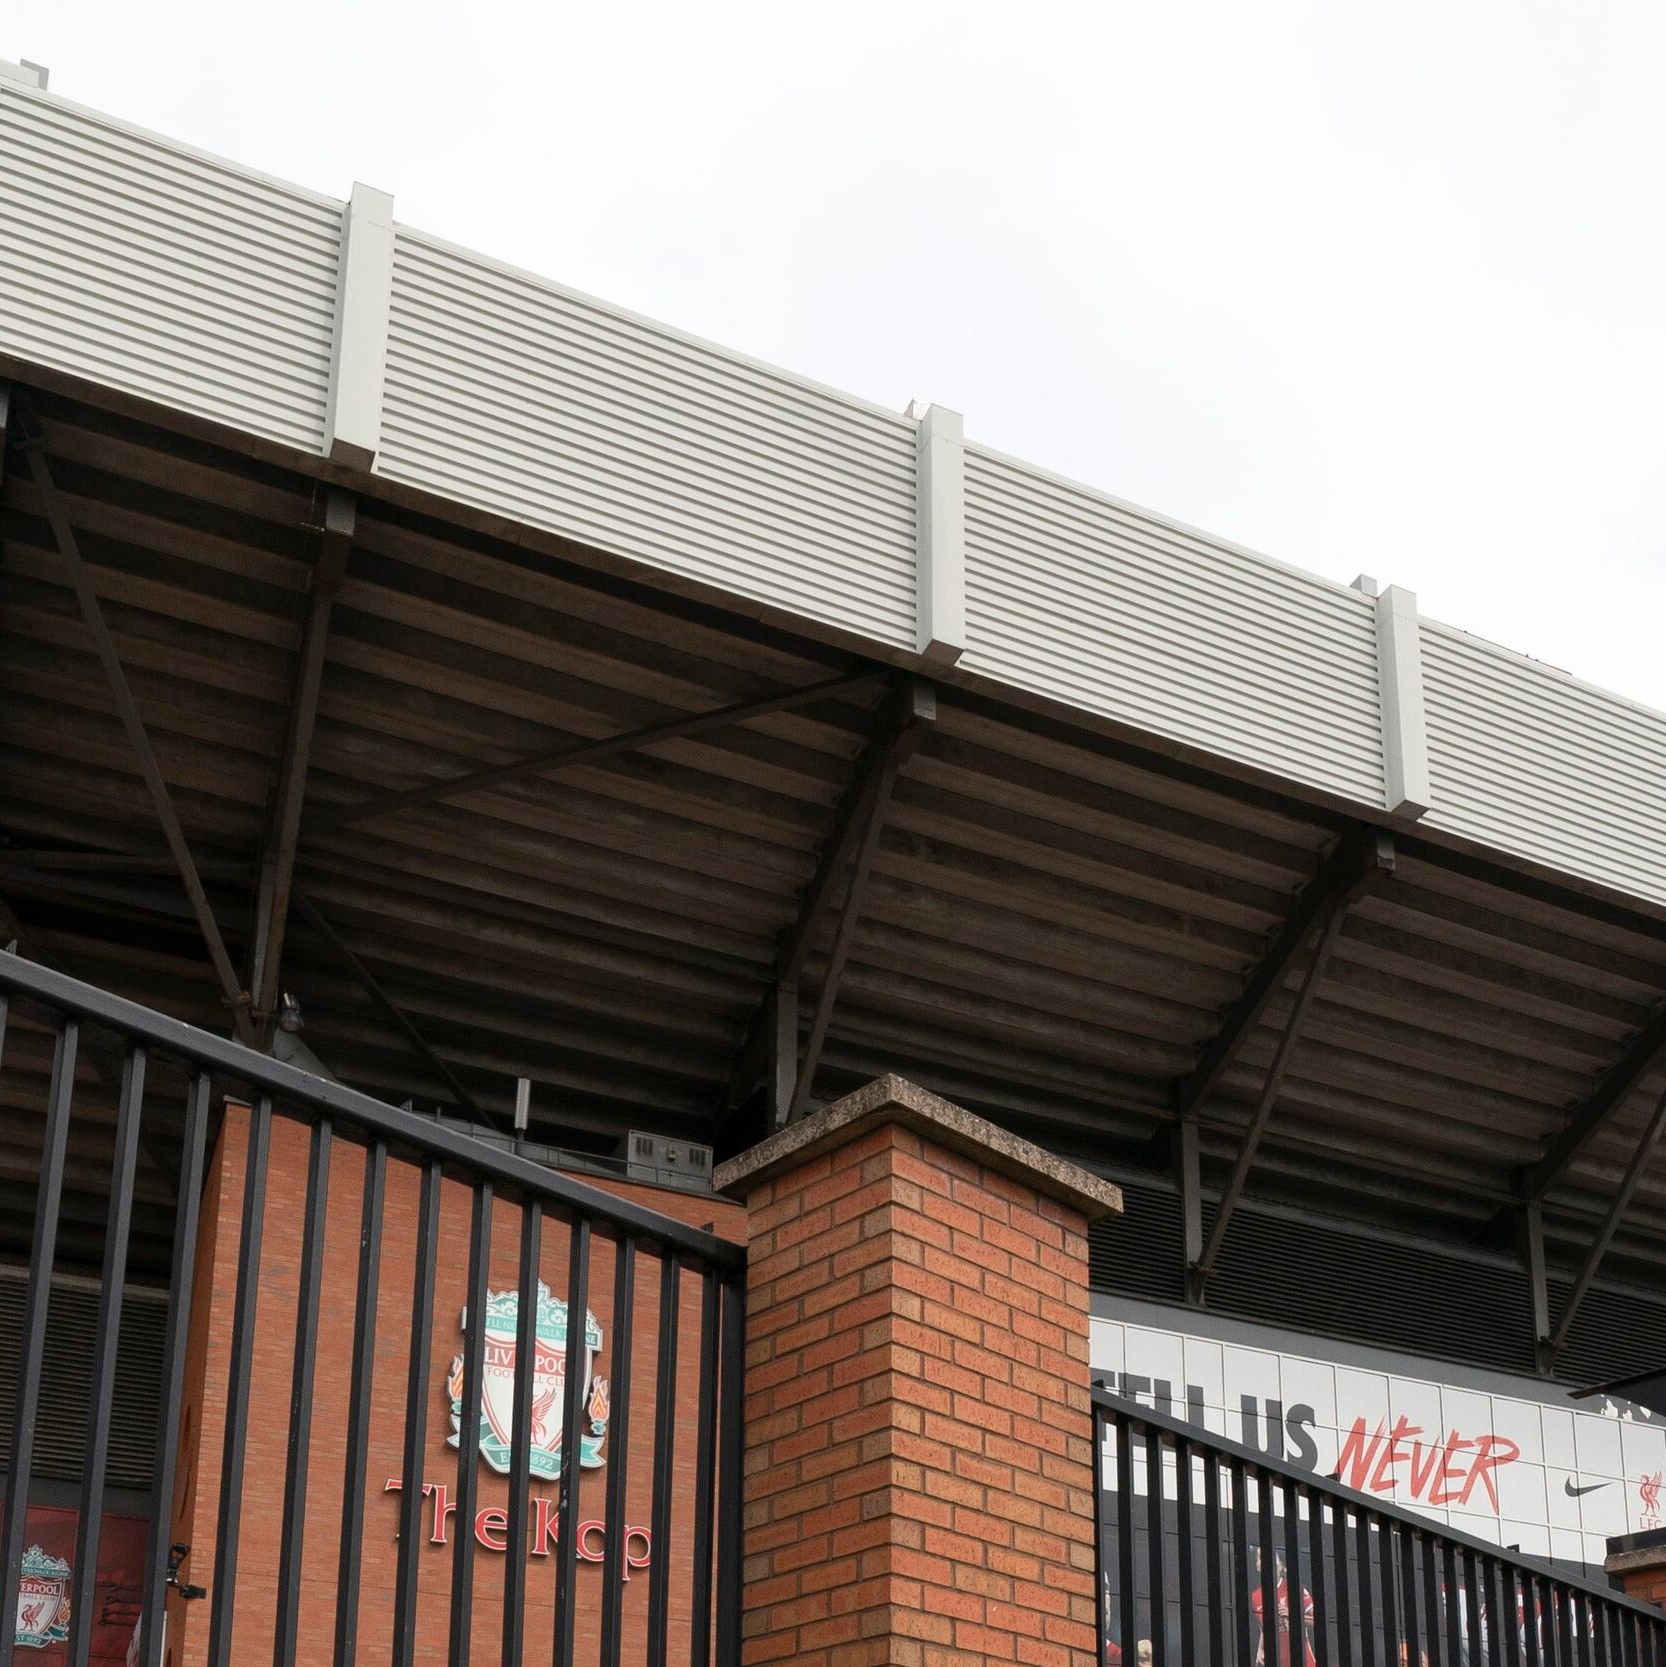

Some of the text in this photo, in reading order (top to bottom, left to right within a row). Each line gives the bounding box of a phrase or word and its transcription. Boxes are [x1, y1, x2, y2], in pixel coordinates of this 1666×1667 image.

[484, 1346, 566, 1375] LIVPOO
[532, 1455, 554, 1470] 892
[1239, 1393, 1319, 1472] US
[1335, 1413, 1521, 1516] NEVER
[20, 1582, 59, 1596] ERPOOL
